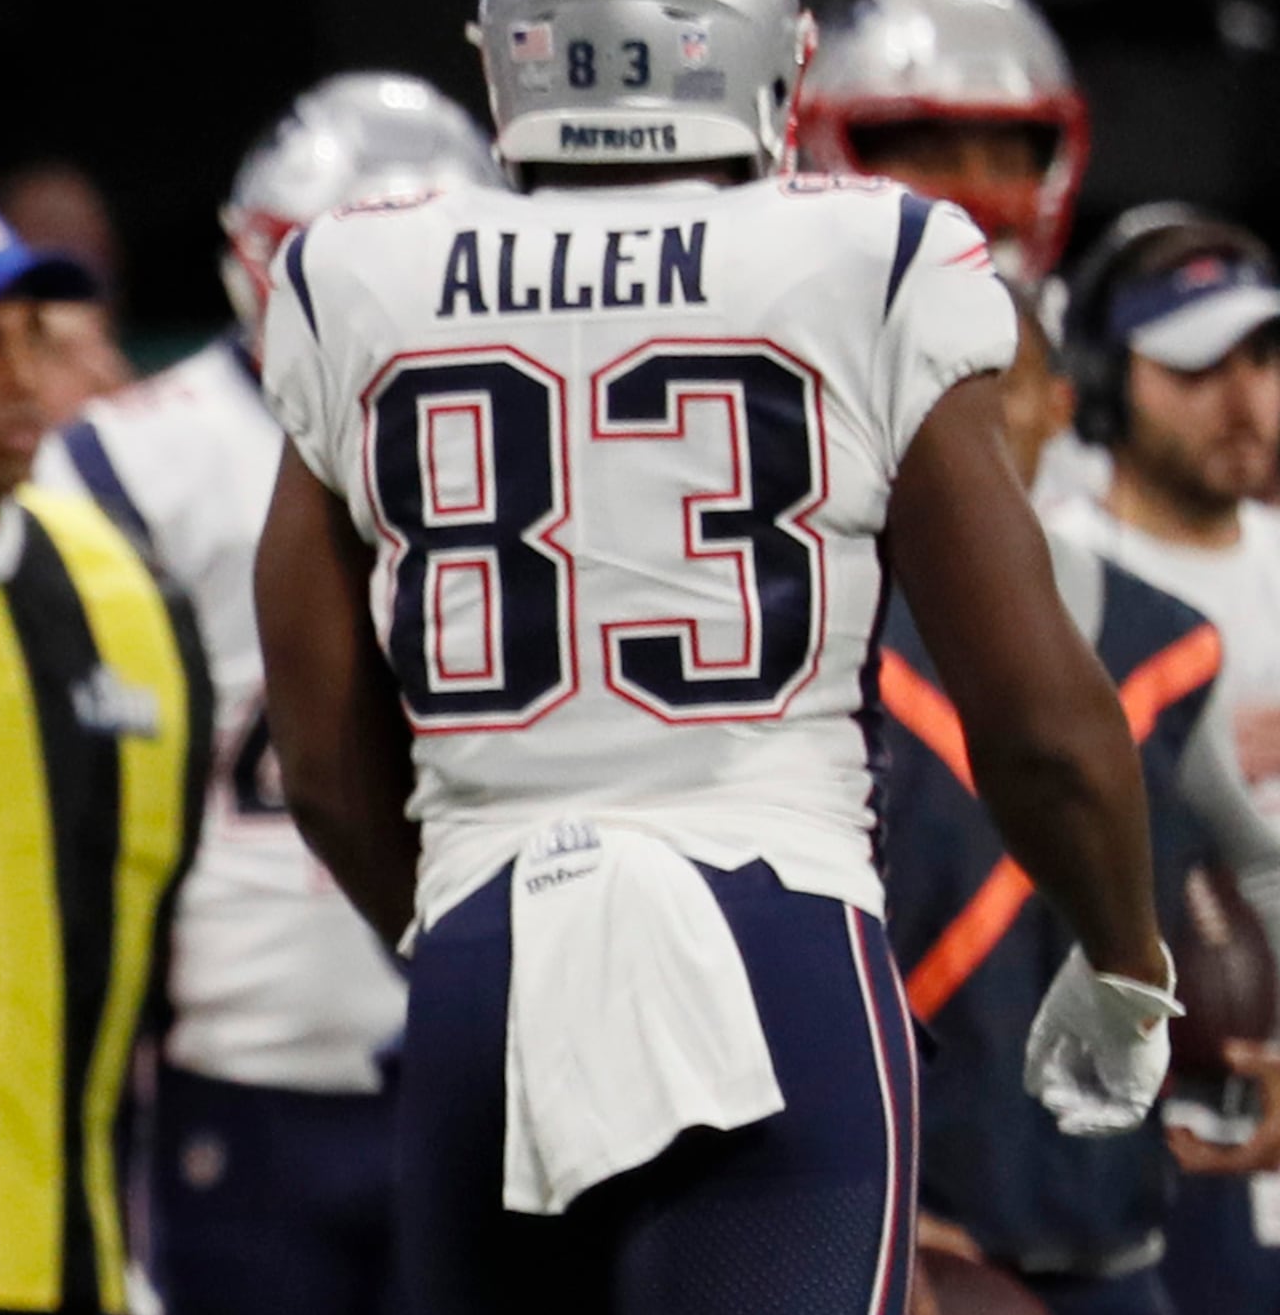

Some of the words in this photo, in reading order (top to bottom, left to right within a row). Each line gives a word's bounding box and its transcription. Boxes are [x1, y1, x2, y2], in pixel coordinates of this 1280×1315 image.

[559, 123, 677, 151] PATRIOTS
[436, 222, 708, 318] ALLEN
[360, 337, 828, 736] 83
